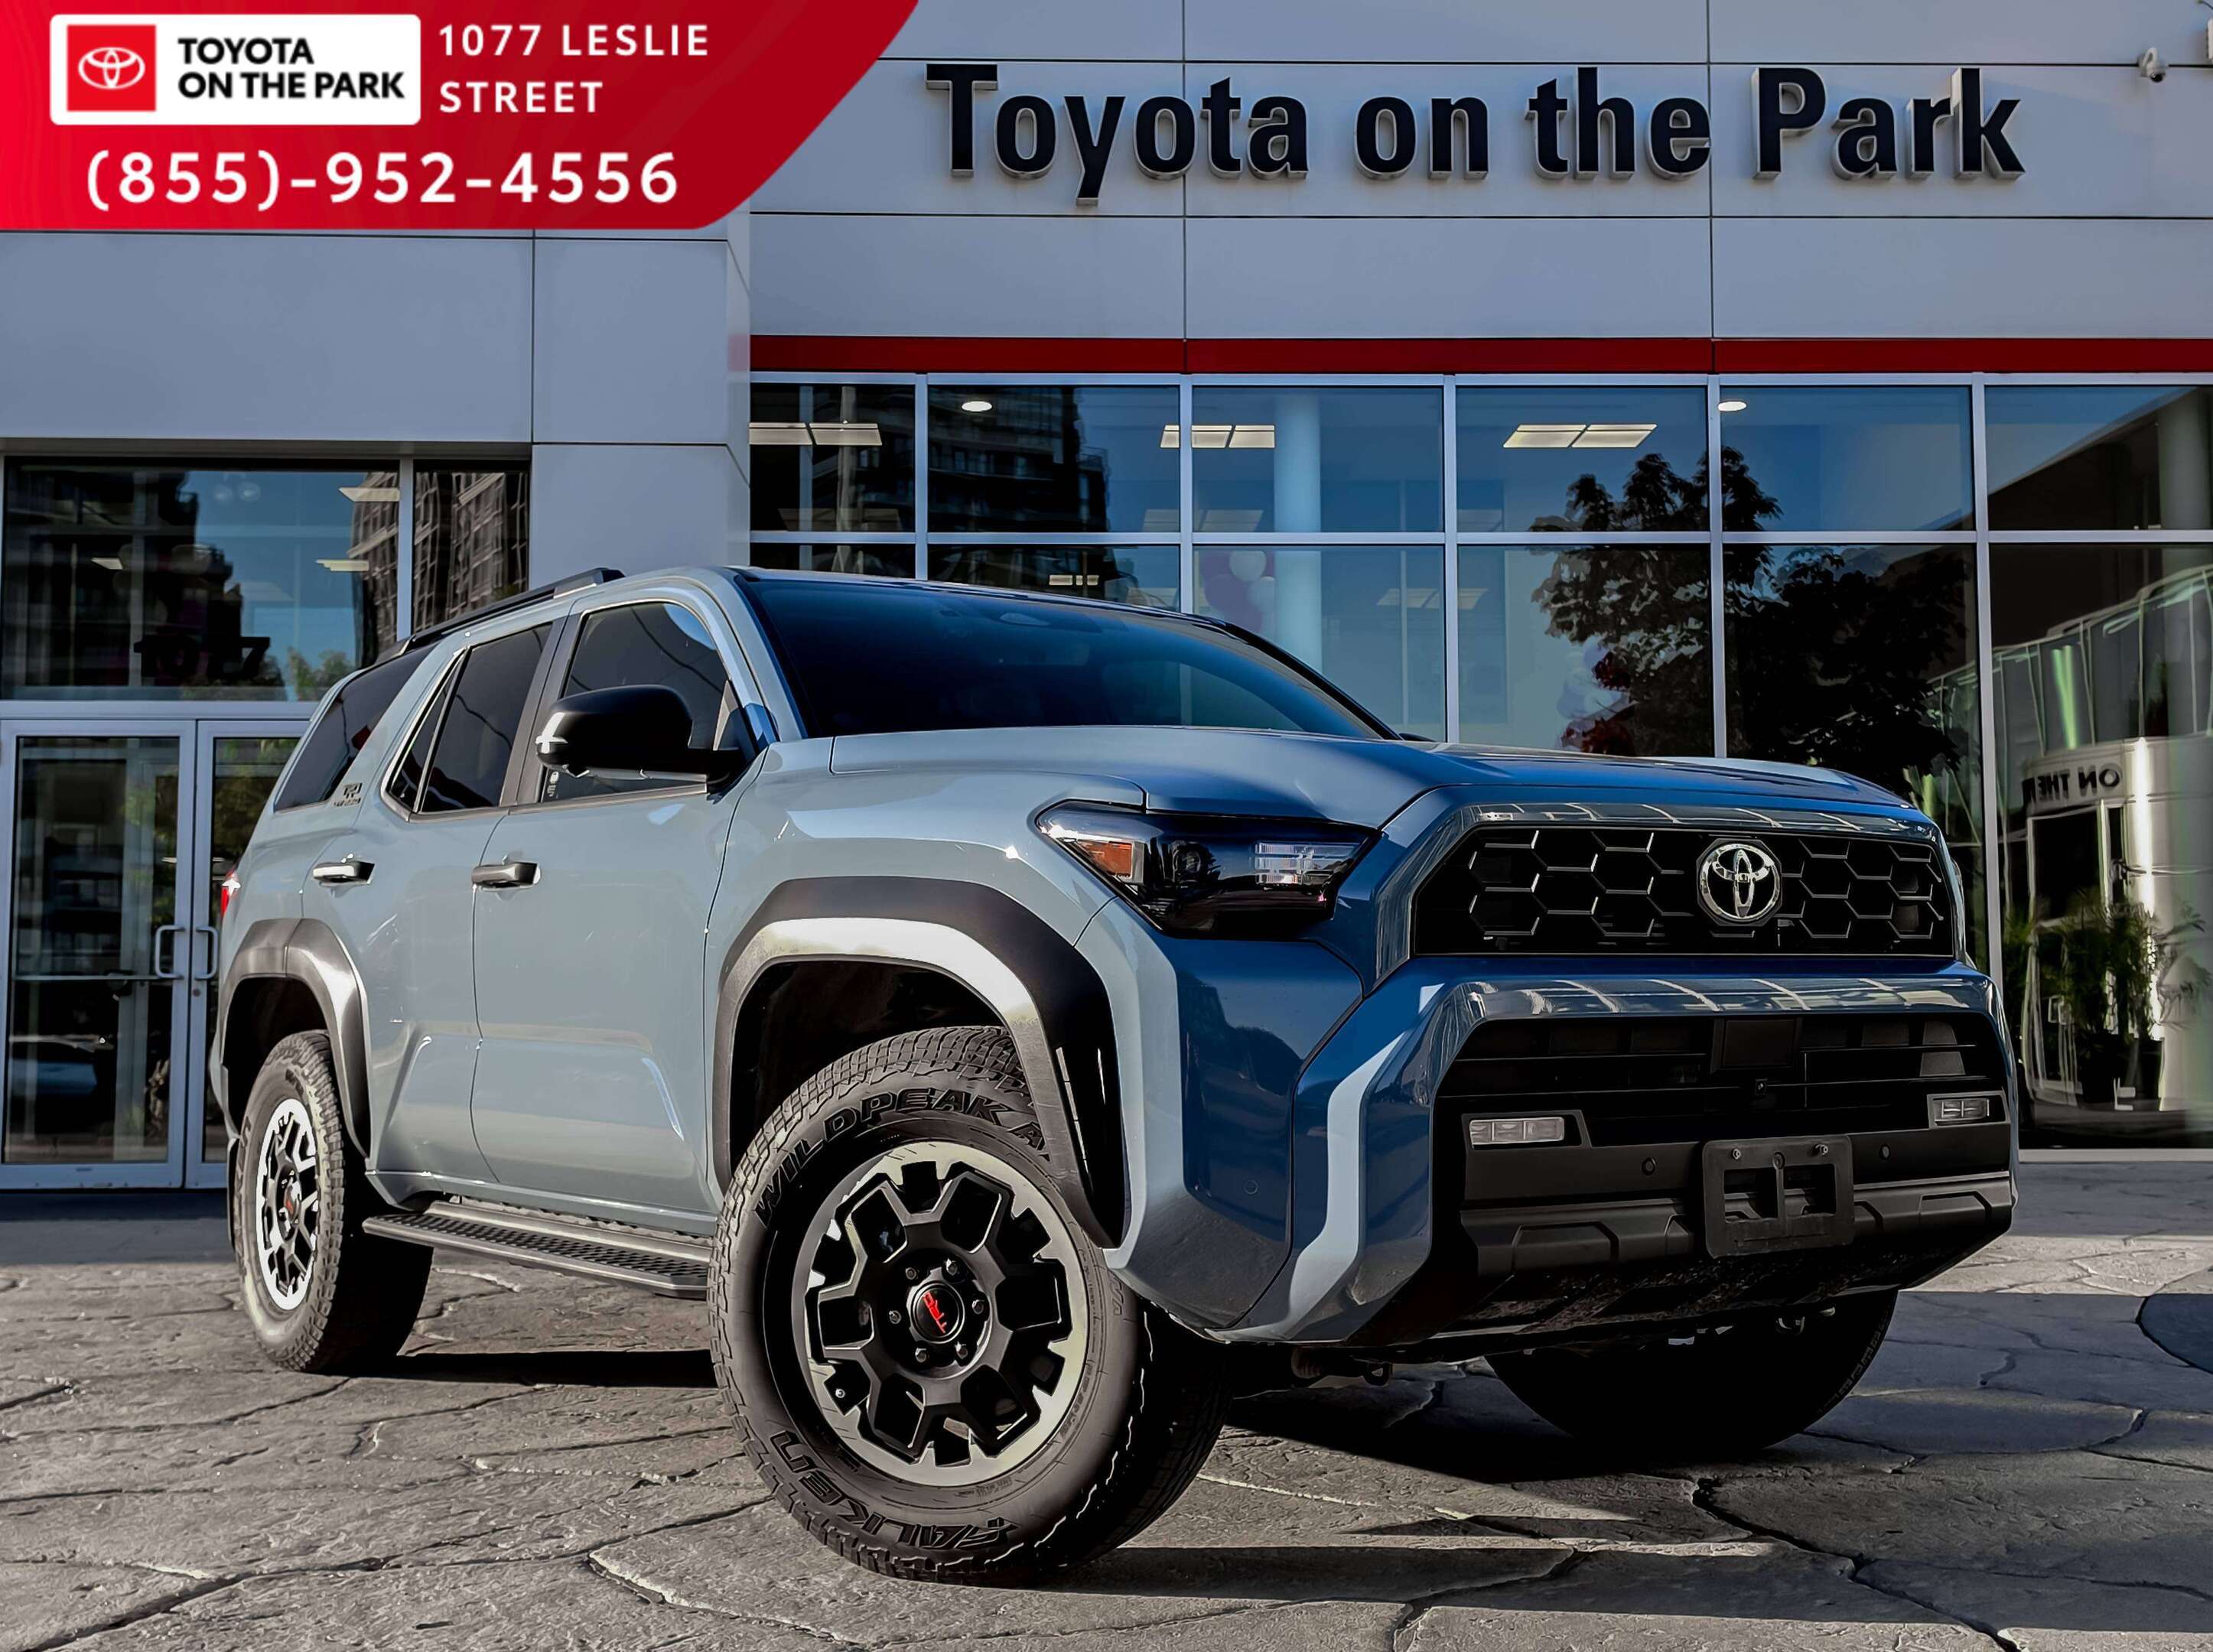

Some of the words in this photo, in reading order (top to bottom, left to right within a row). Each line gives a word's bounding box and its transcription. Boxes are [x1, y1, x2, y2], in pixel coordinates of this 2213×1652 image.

[926, 63, 1309, 206] Toyota
[1355, 95, 1490, 180] on
[1524, 67, 1710, 181] the
[1752, 67, 2026, 182] Park
[754, 1087, 1011, 1228] WILDPEAK
[769, 1429, 1020, 1550] FALKEN
